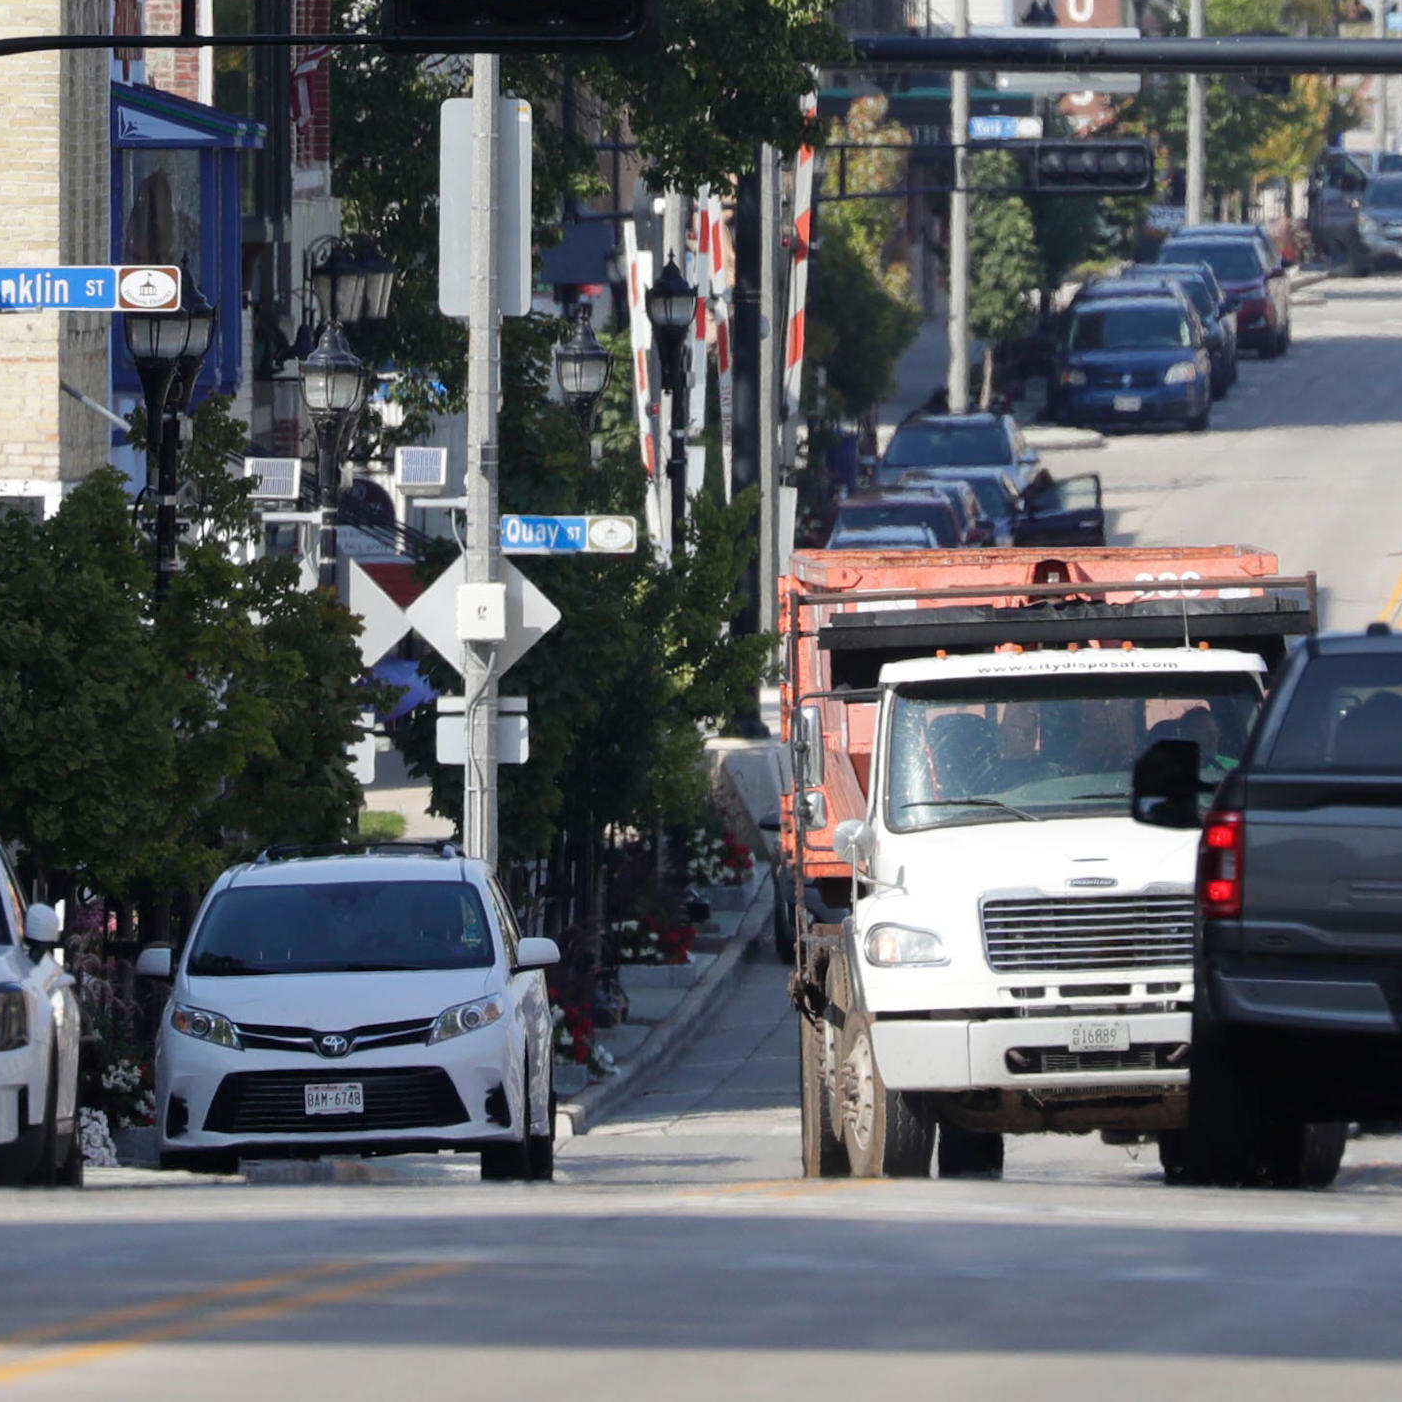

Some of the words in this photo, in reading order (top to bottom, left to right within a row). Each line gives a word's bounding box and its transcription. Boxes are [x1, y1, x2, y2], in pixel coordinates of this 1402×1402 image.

[85, 280, 104, 297] ST
[506, 518, 559, 548] Quay
[566, 525, 582, 541] ST
[978, 660, 1179, 674] www.citydisposal.com
[1082, 1028, 1117, 1044] 16889
[307, 1091, 362, 1107] BAM-6748
